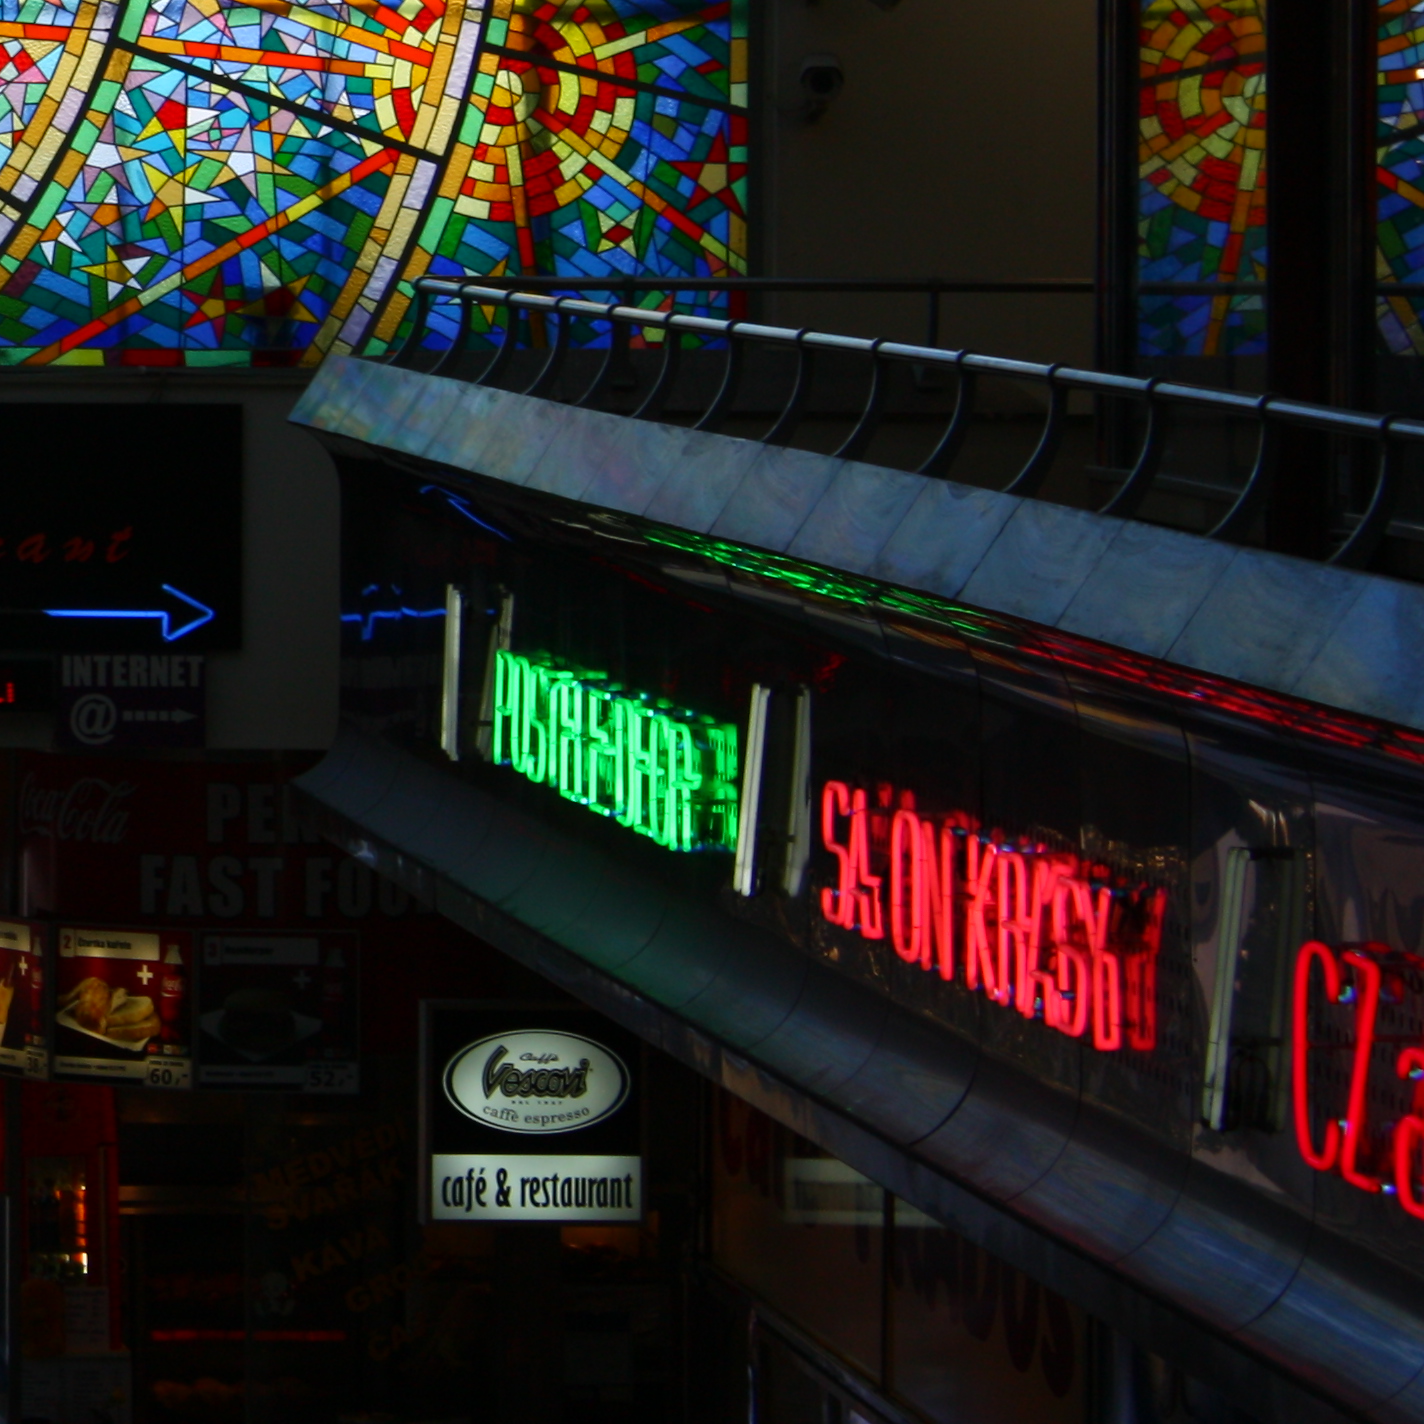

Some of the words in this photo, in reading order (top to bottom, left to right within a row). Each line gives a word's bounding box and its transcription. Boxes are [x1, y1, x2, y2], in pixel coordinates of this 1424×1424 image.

[60, 653, 205, 688] INTERNET
[138, 853, 285, 919] FAST
[63, 935, 72, 950] 2
[482, 1103, 520, 1124] caffè
[523, 1106, 591, 1126] espresso
[441, 1167, 488, 1213] café
[495, 1168, 512, 1208] &
[519, 1173, 634, 1209] restaurant
